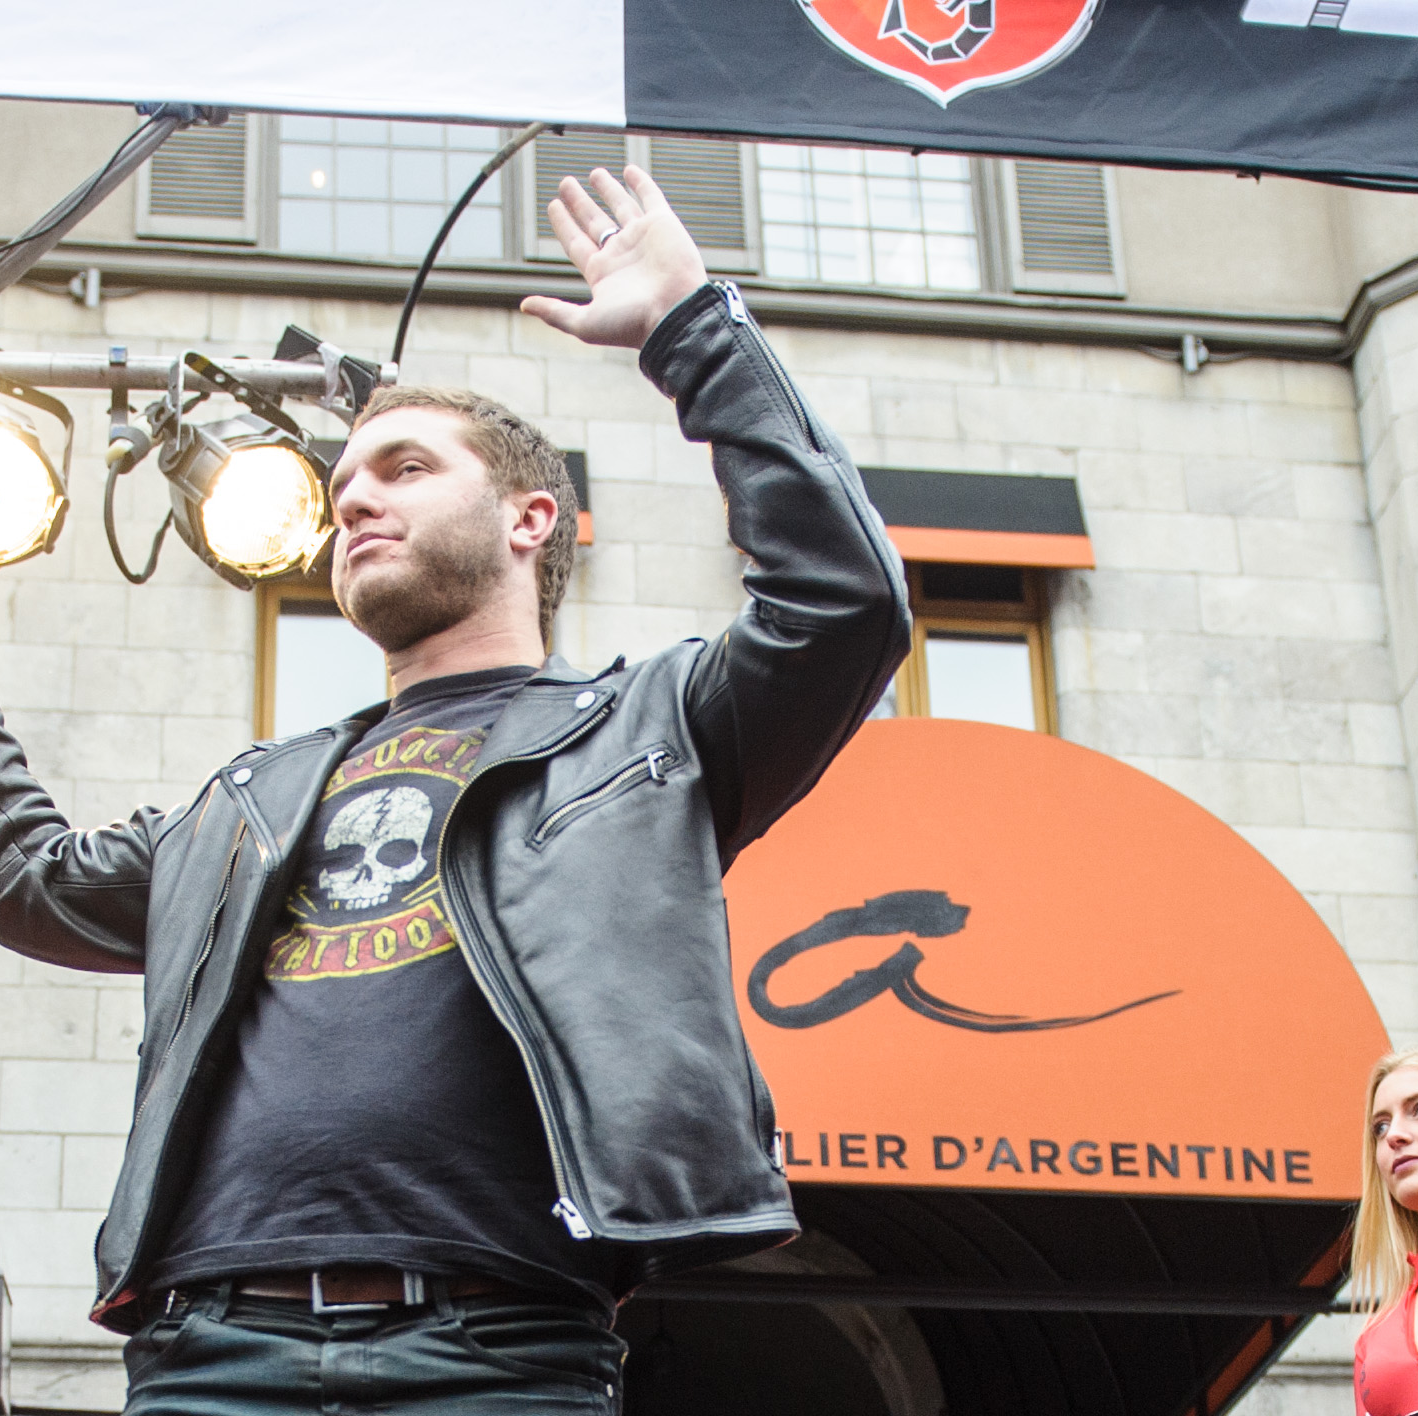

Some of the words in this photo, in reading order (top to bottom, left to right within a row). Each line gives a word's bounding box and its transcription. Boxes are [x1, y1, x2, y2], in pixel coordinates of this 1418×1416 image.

[269, 916, 433, 972] TATTOO
[785, 1132, 908, 1170] LIER
[933, 1136, 1314, 1185] D'ARGENTINE
